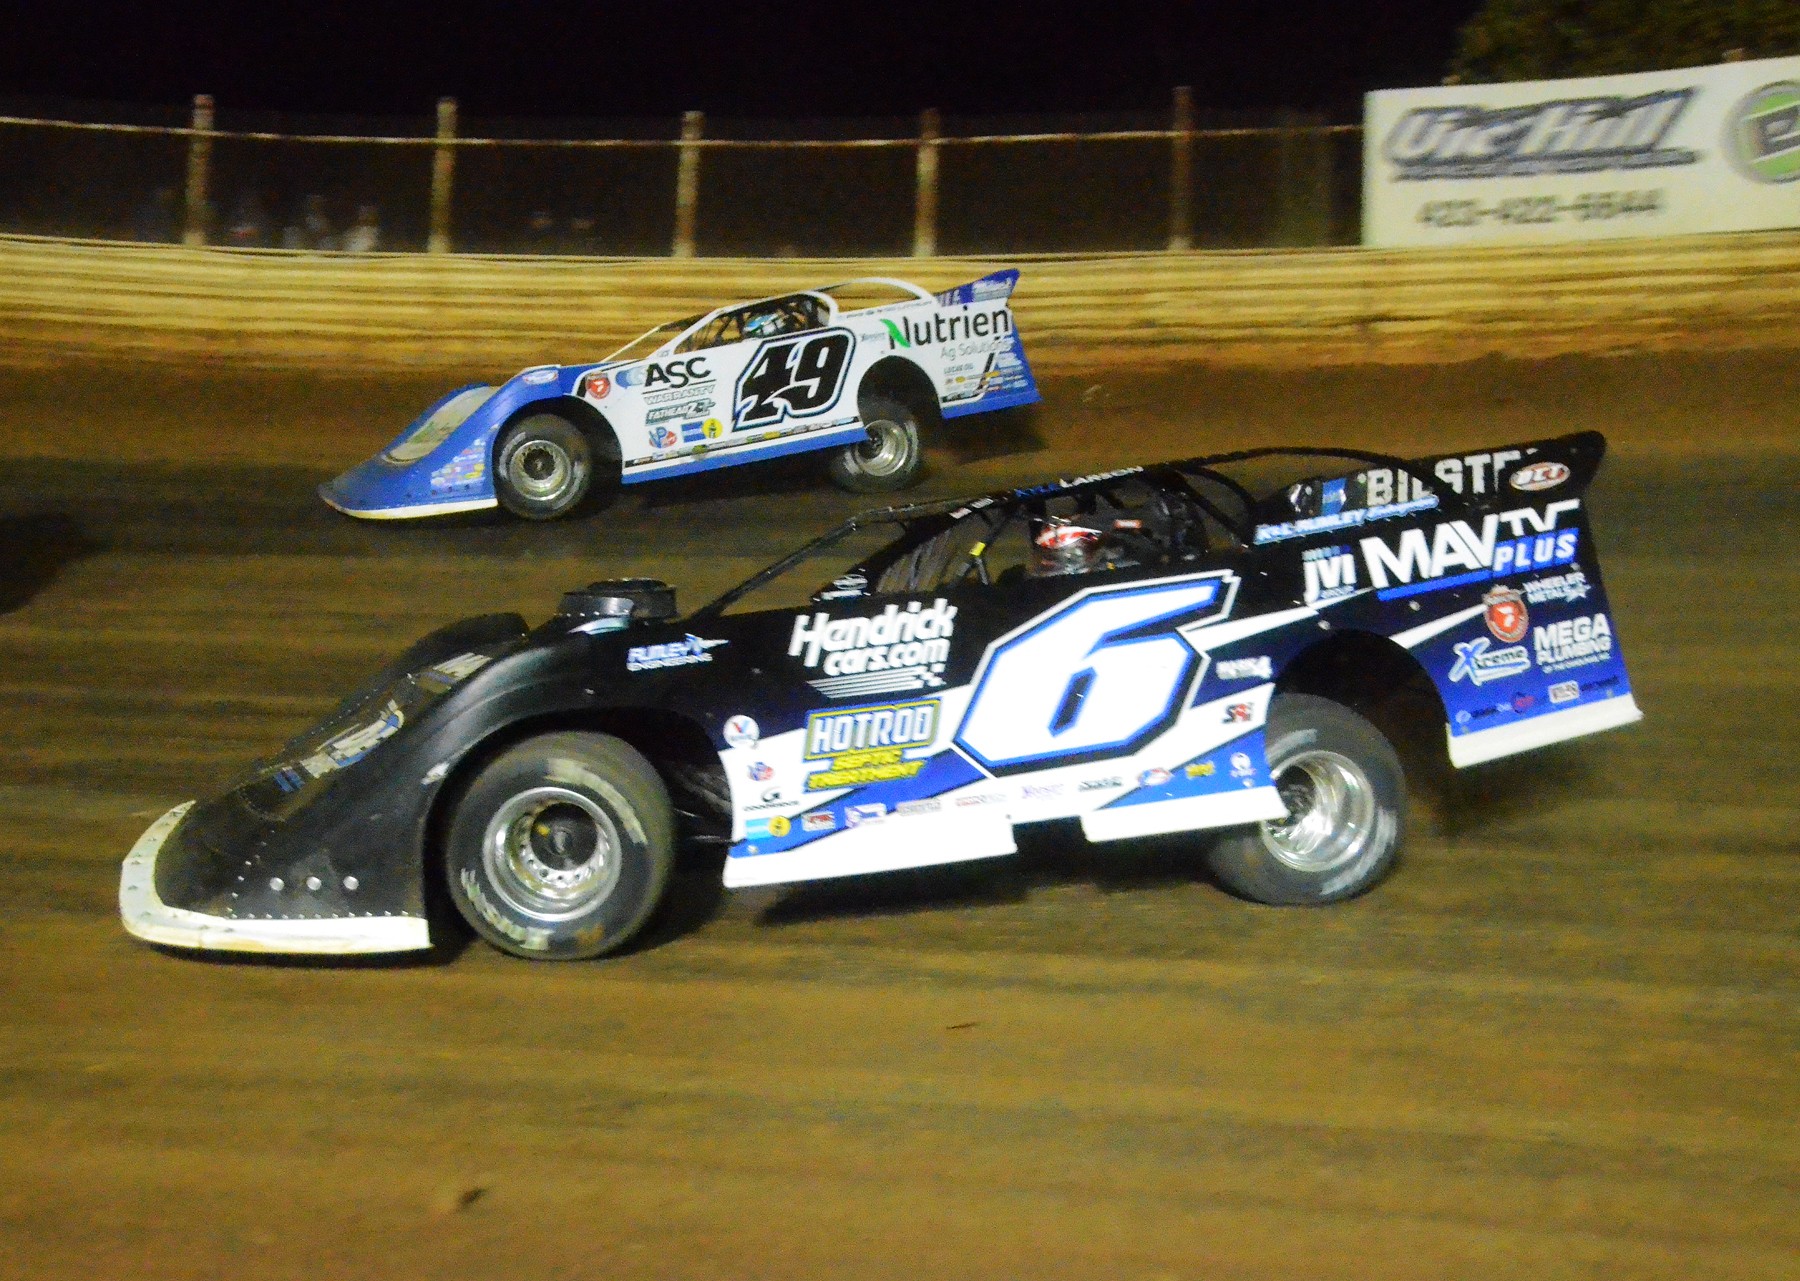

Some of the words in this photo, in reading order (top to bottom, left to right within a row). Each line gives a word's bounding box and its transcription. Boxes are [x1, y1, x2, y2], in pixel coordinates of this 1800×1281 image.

[880, 305, 1009, 350] Nutrien
[644, 357, 711, 389] ASC
[735, 329, 854, 431] 49
[1359, 498, 1581, 589] MAVTV
[1492, 533, 1578, 572] PLUS
[788, 598, 958, 668] Hendrick
[1534, 613, 1611, 651] MEGA
[823, 638, 950, 676] cars.com
[953, 572, 1230, 770] 6
